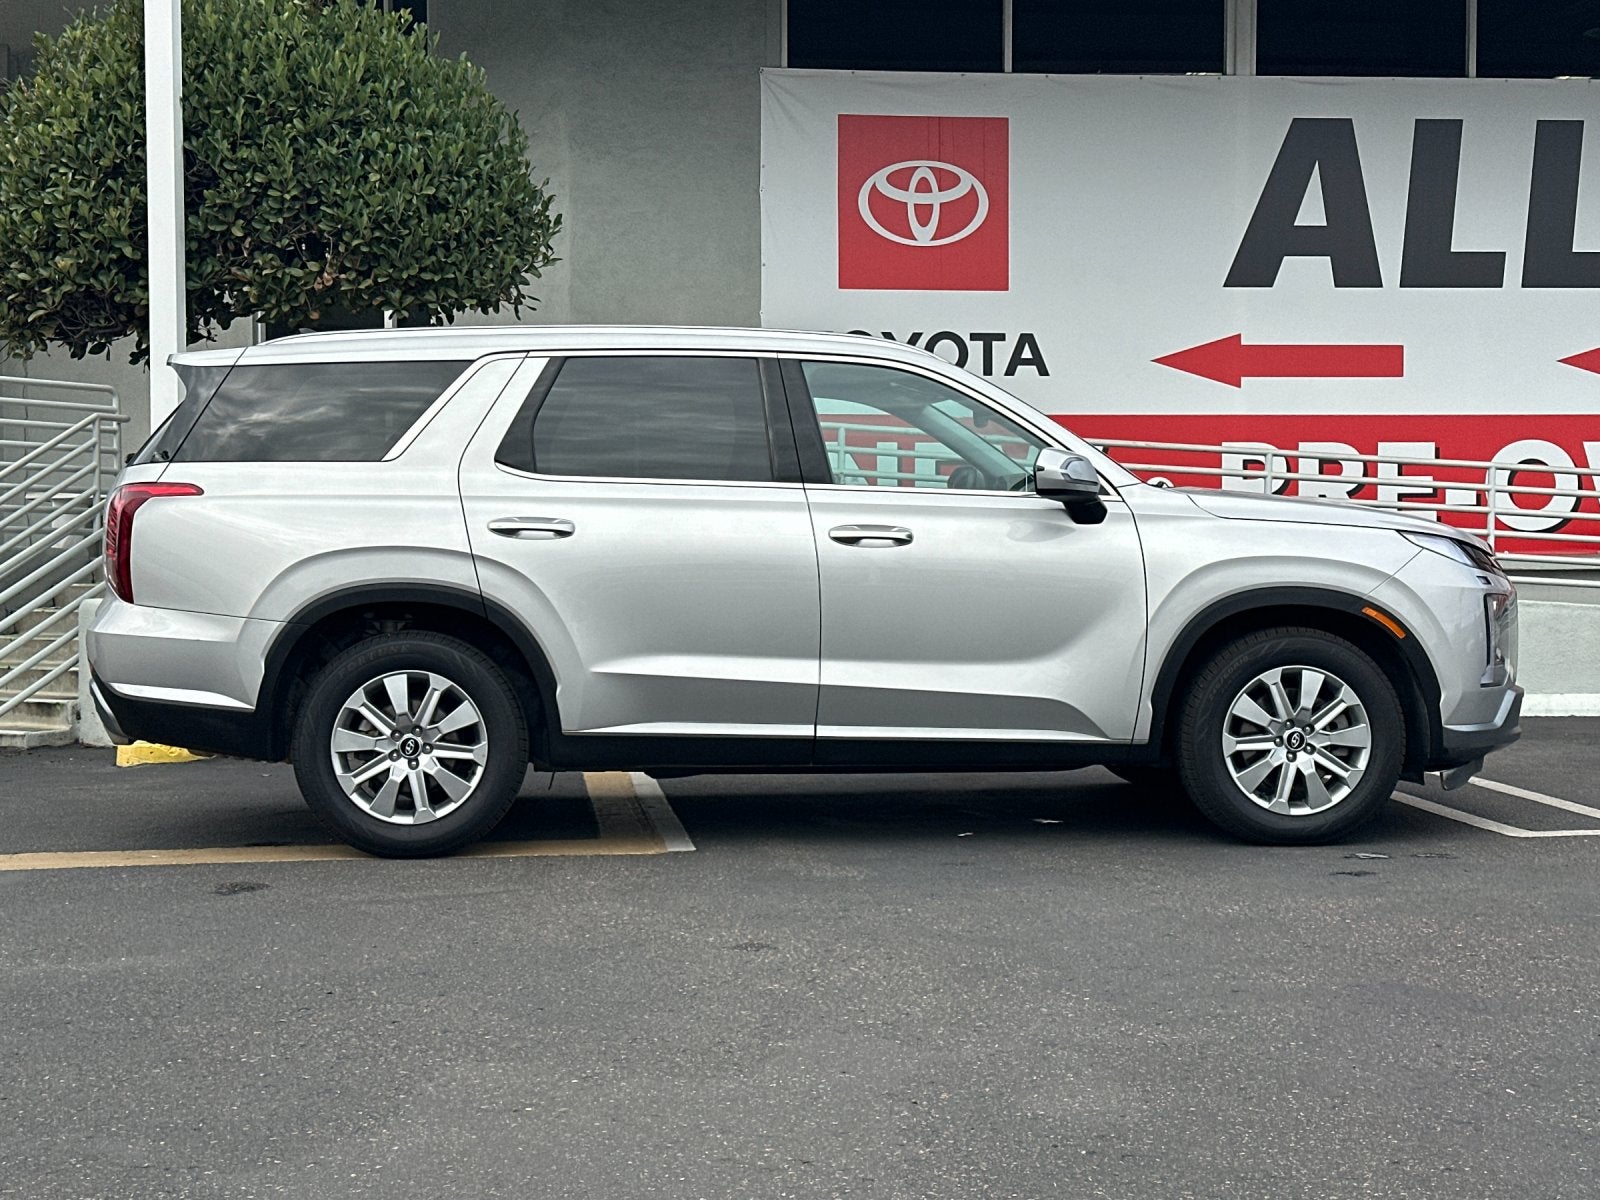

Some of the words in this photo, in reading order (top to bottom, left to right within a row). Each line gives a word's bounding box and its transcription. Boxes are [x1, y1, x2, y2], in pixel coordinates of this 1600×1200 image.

[1222, 117, 1600, 289] ALL
[820, 329, 1050, 377] OTA
[1221, 439, 1600, 533] PRE-O
